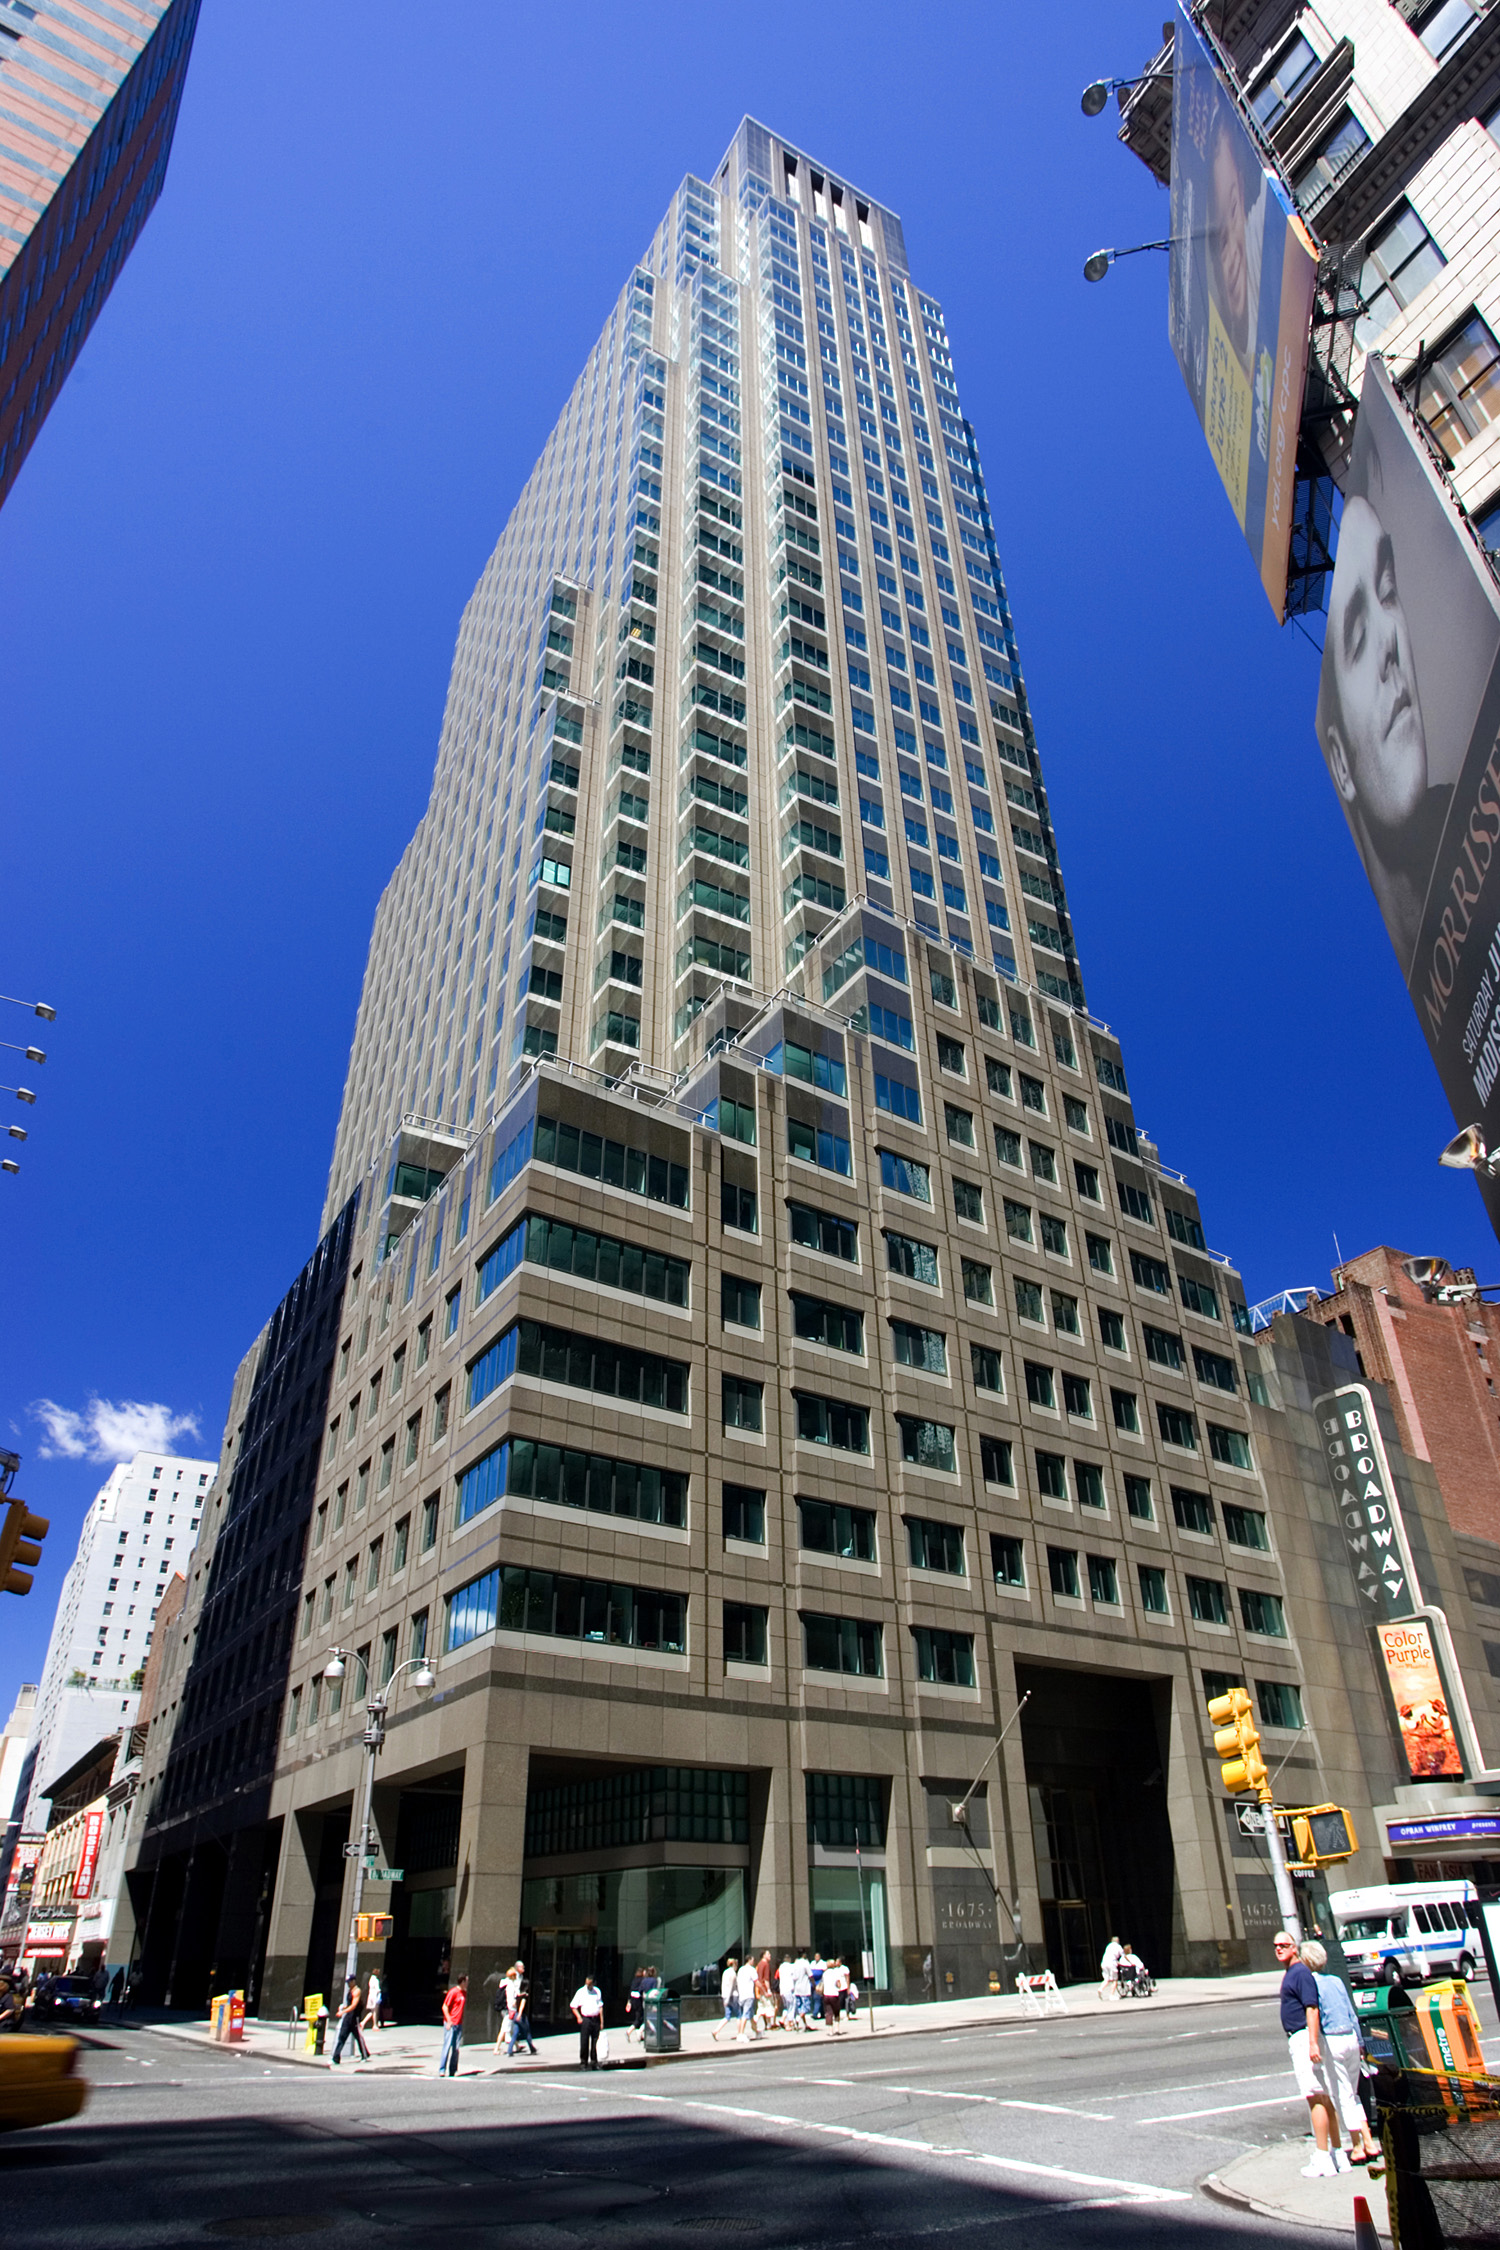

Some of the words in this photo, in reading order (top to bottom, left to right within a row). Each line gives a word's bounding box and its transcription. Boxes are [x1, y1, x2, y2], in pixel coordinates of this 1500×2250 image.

[1219, 341, 1228, 372] 2
[1208, 325, 1219, 444] Saturday
[1216, 376, 1227, 466] June
[1271, 345, 1291, 531] yai.org/cpc
[1462, 968, 1495, 1064] SATURDAY
[1344, 1409, 1404, 1600] BROADWAY
[1384, 1631, 1424, 1648] Color
[1385, 1645, 1431, 1665] Purple
[1245, 1813, 1262, 1826] ONE
[1400, 1825, 1424, 1836] OPRAH
[1425, 1823, 1456, 1833] WINFREY
[1472, 1821, 1497, 1829] presents
[76, 1815, 100, 1897] ROSELAND
[1293, 1869, 1316, 1878] COFFEE
[1417, 1863, 1466, 1879] FANASIA
[948, 1902, 985, 1918] 1675
[1247, 1904, 1274, 1917] 1675
[28, 1923, 52, 1939] JERSEY
[942, 1920, 992, 1929] BROADWAY
[1437, 2027, 1454, 2067] metro
